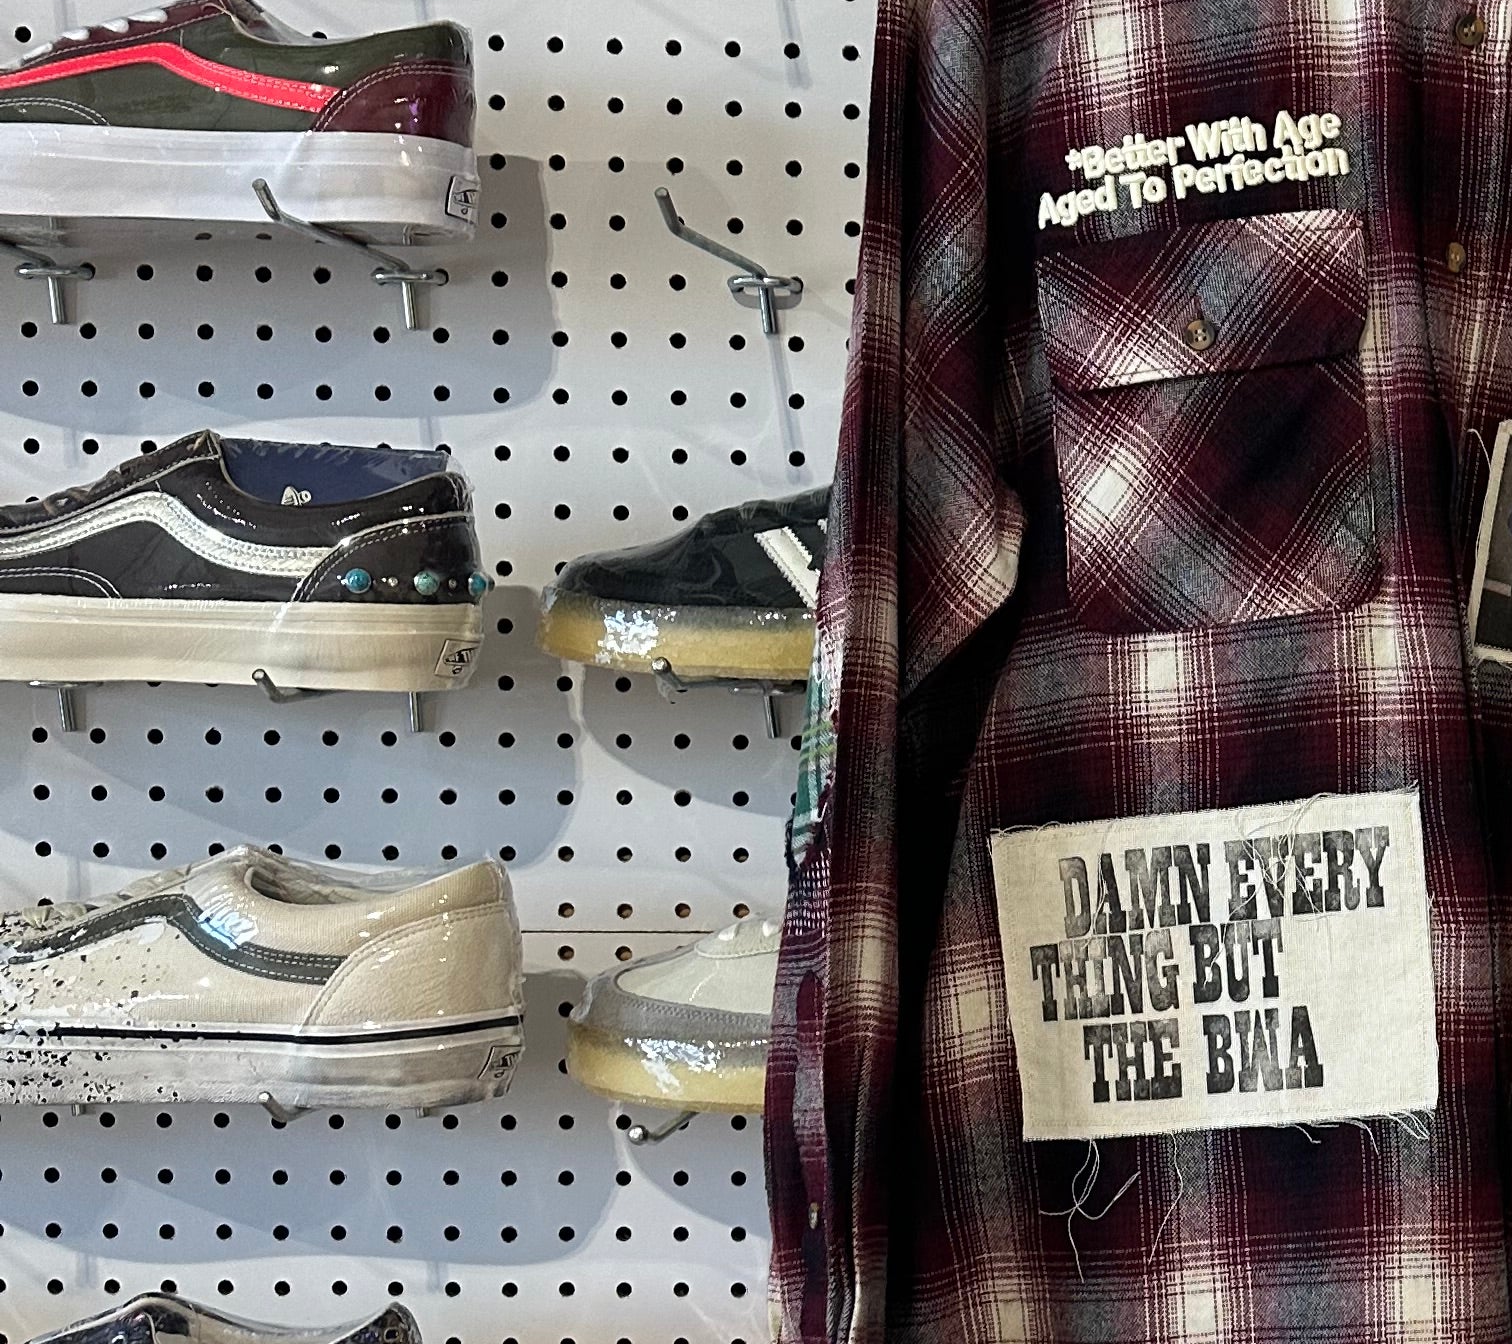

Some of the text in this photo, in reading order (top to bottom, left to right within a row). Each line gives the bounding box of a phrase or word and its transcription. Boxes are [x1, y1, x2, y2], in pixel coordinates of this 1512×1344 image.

[1185, 116, 1268, 162] With
[1272, 109, 1343, 155] Age
[1038, 144, 1351, 230] Aged To Perfection
[1058, 825, 1391, 939] DAMN EVERY
[1029, 917, 1284, 1022] THING BUT
[1082, 1017, 1183, 1104] THE
